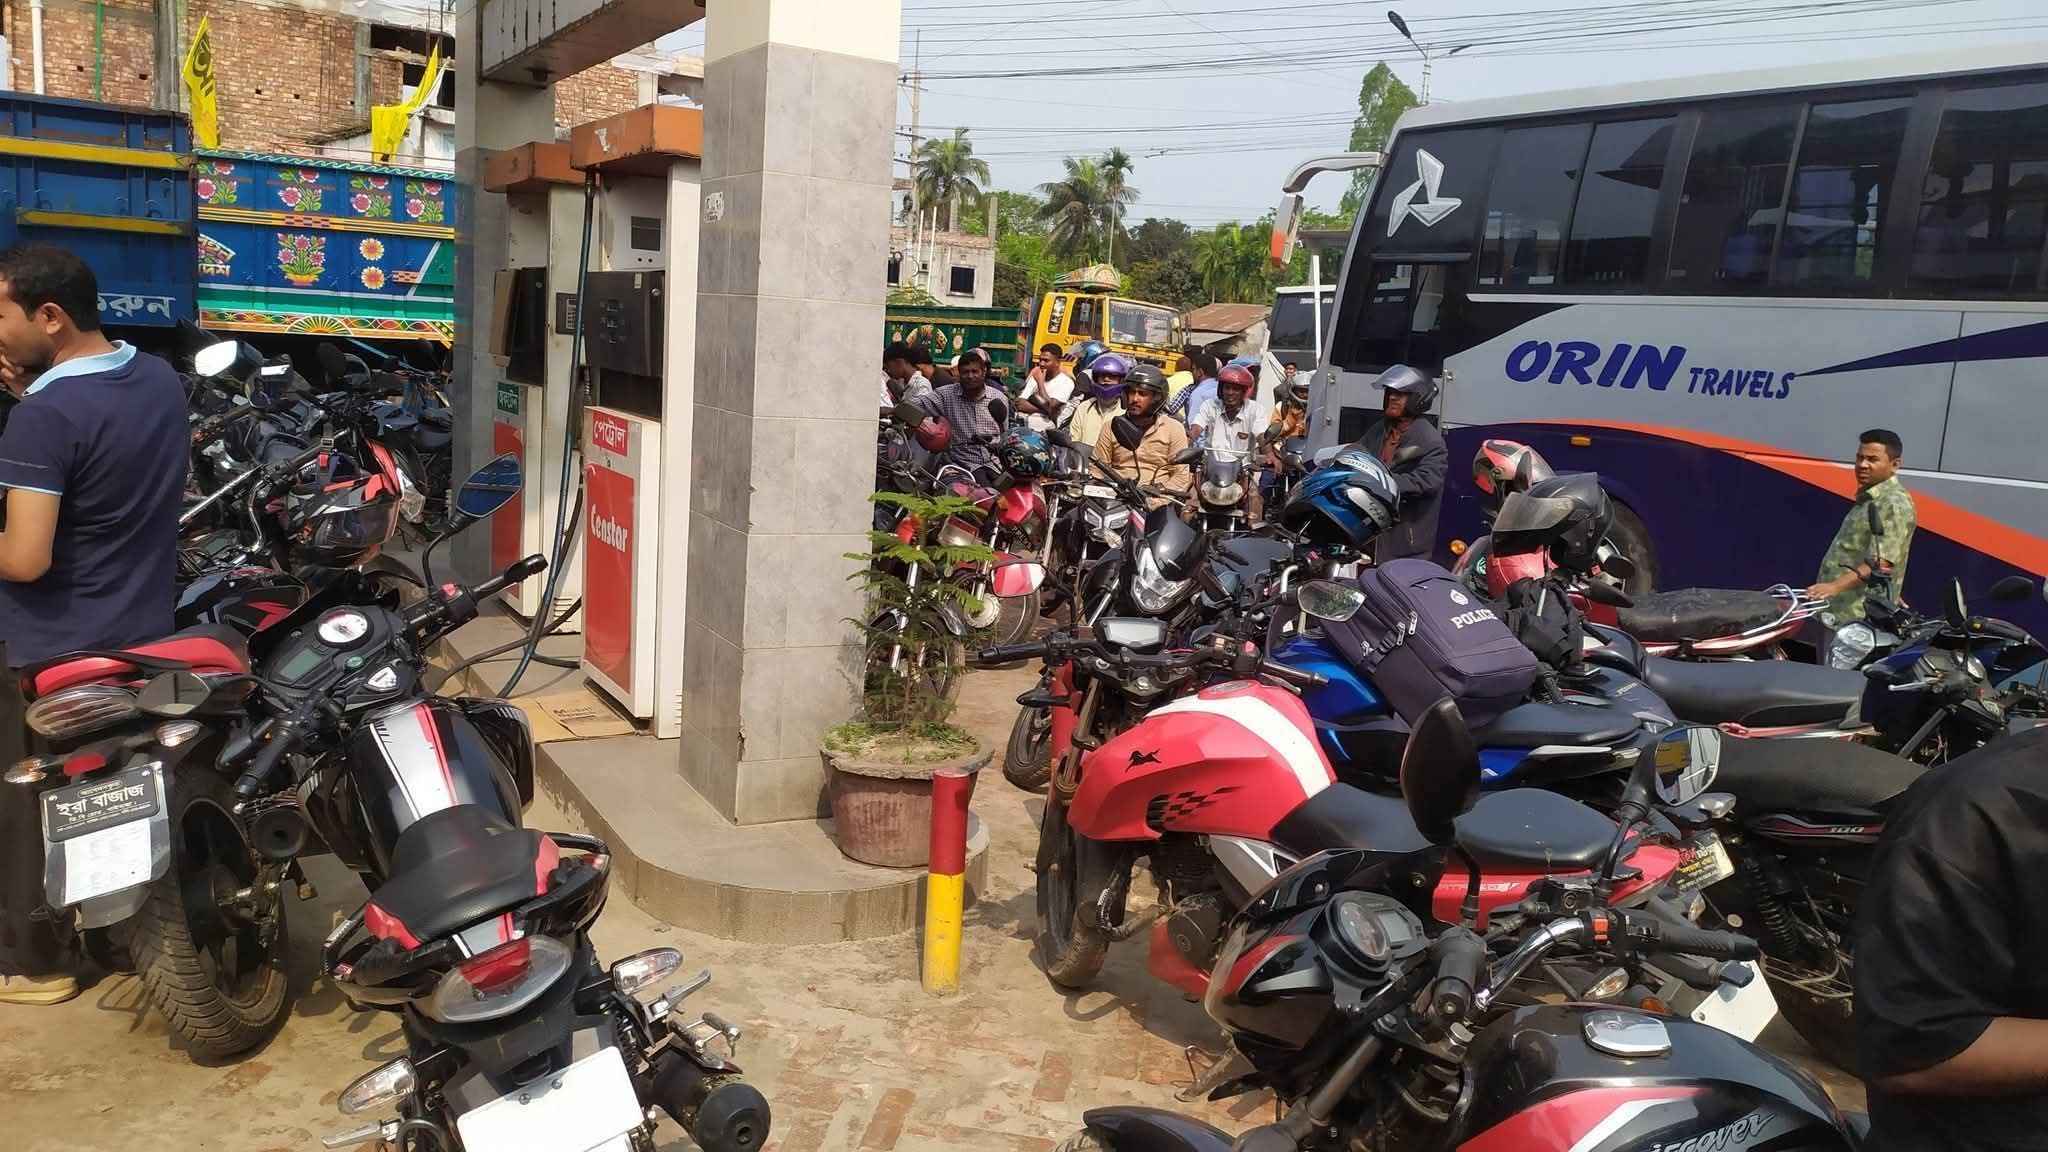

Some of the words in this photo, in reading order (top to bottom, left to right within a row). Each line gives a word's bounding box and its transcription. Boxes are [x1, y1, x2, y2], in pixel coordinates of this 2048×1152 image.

[1505, 340, 1687, 391] ORIN
[1687, 367, 1796, 399] TRAVELS
[593, 419, 627, 449] পেট্রোল
[590, 503, 629, 553] Censtar
[56, 798, 88, 817] ইরা
[91, 783, 145, 808] বাজাজ
